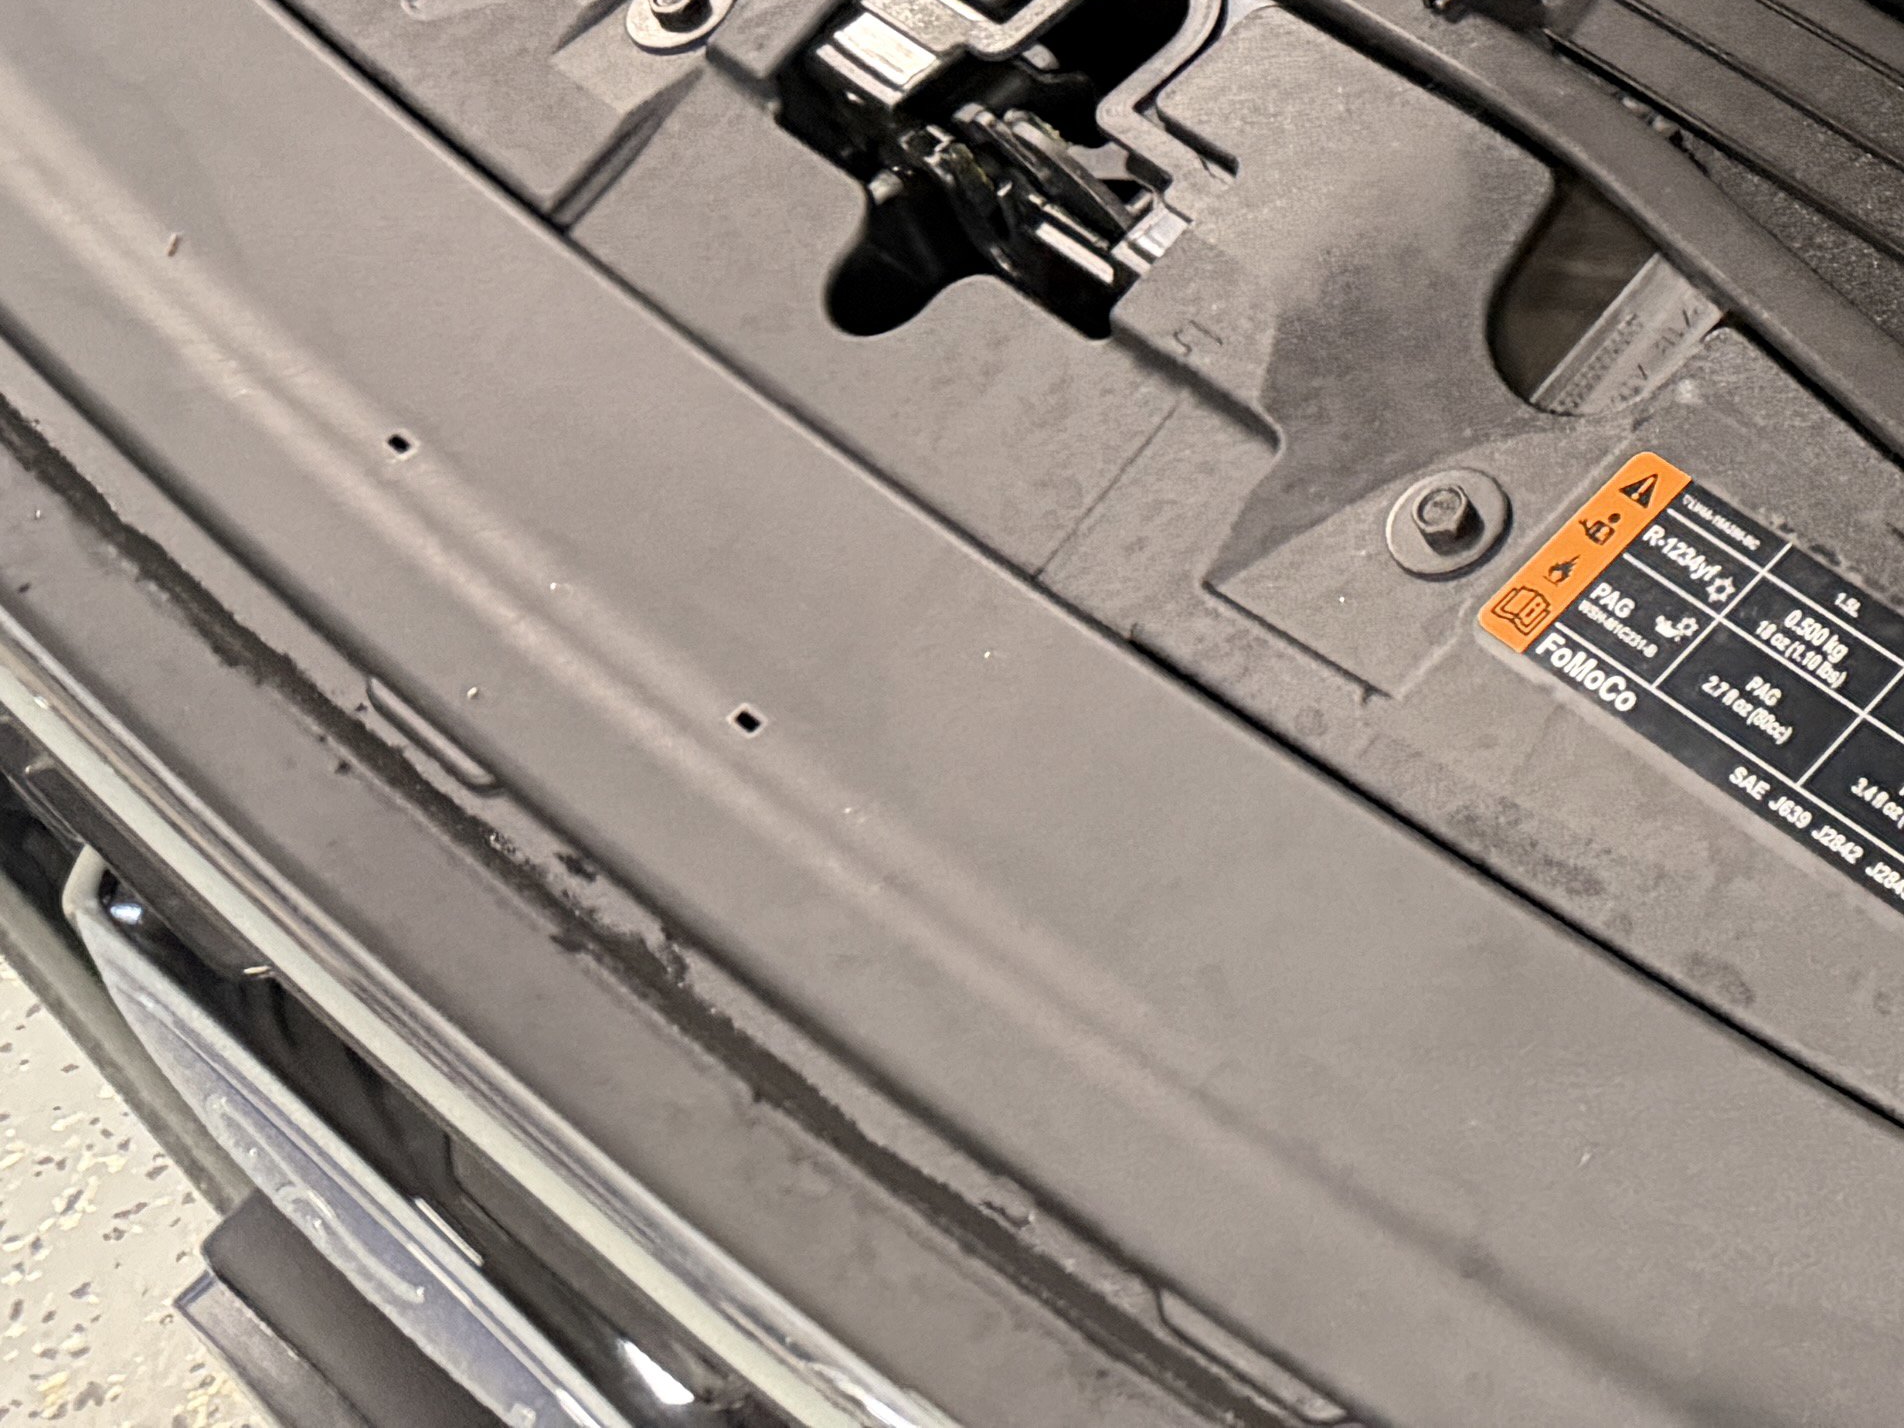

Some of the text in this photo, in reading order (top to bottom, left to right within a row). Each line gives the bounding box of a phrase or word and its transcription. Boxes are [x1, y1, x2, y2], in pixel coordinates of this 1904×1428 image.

[1641, 524, 1719, 582] R-1234yf
[1588, 581, 1636, 619] PAG
[1834, 592, 1861, 618] 1.5L
[1754, 620, 1778, 643] 18
[1769, 632, 1792, 653] oz
[1811, 658, 1847, 695] lbs)
[1783, 609, 1849, 664] 0.500 kg
[1534, 631, 1637, 712] FoMoCo
[1744, 675, 1782, 707] PAG
[1701, 675, 1731, 702] 2.7
[1731, 698, 1754, 719] oz
[1745, 706, 1793, 745] (80cc)
[1728, 765, 1771, 801] SAE
[1767, 795, 1813, 829] J639
[1810, 824, 1864, 865] J2842
[1850, 777, 1879, 803] 3.4
[1882, 796, 1904, 824] oz
